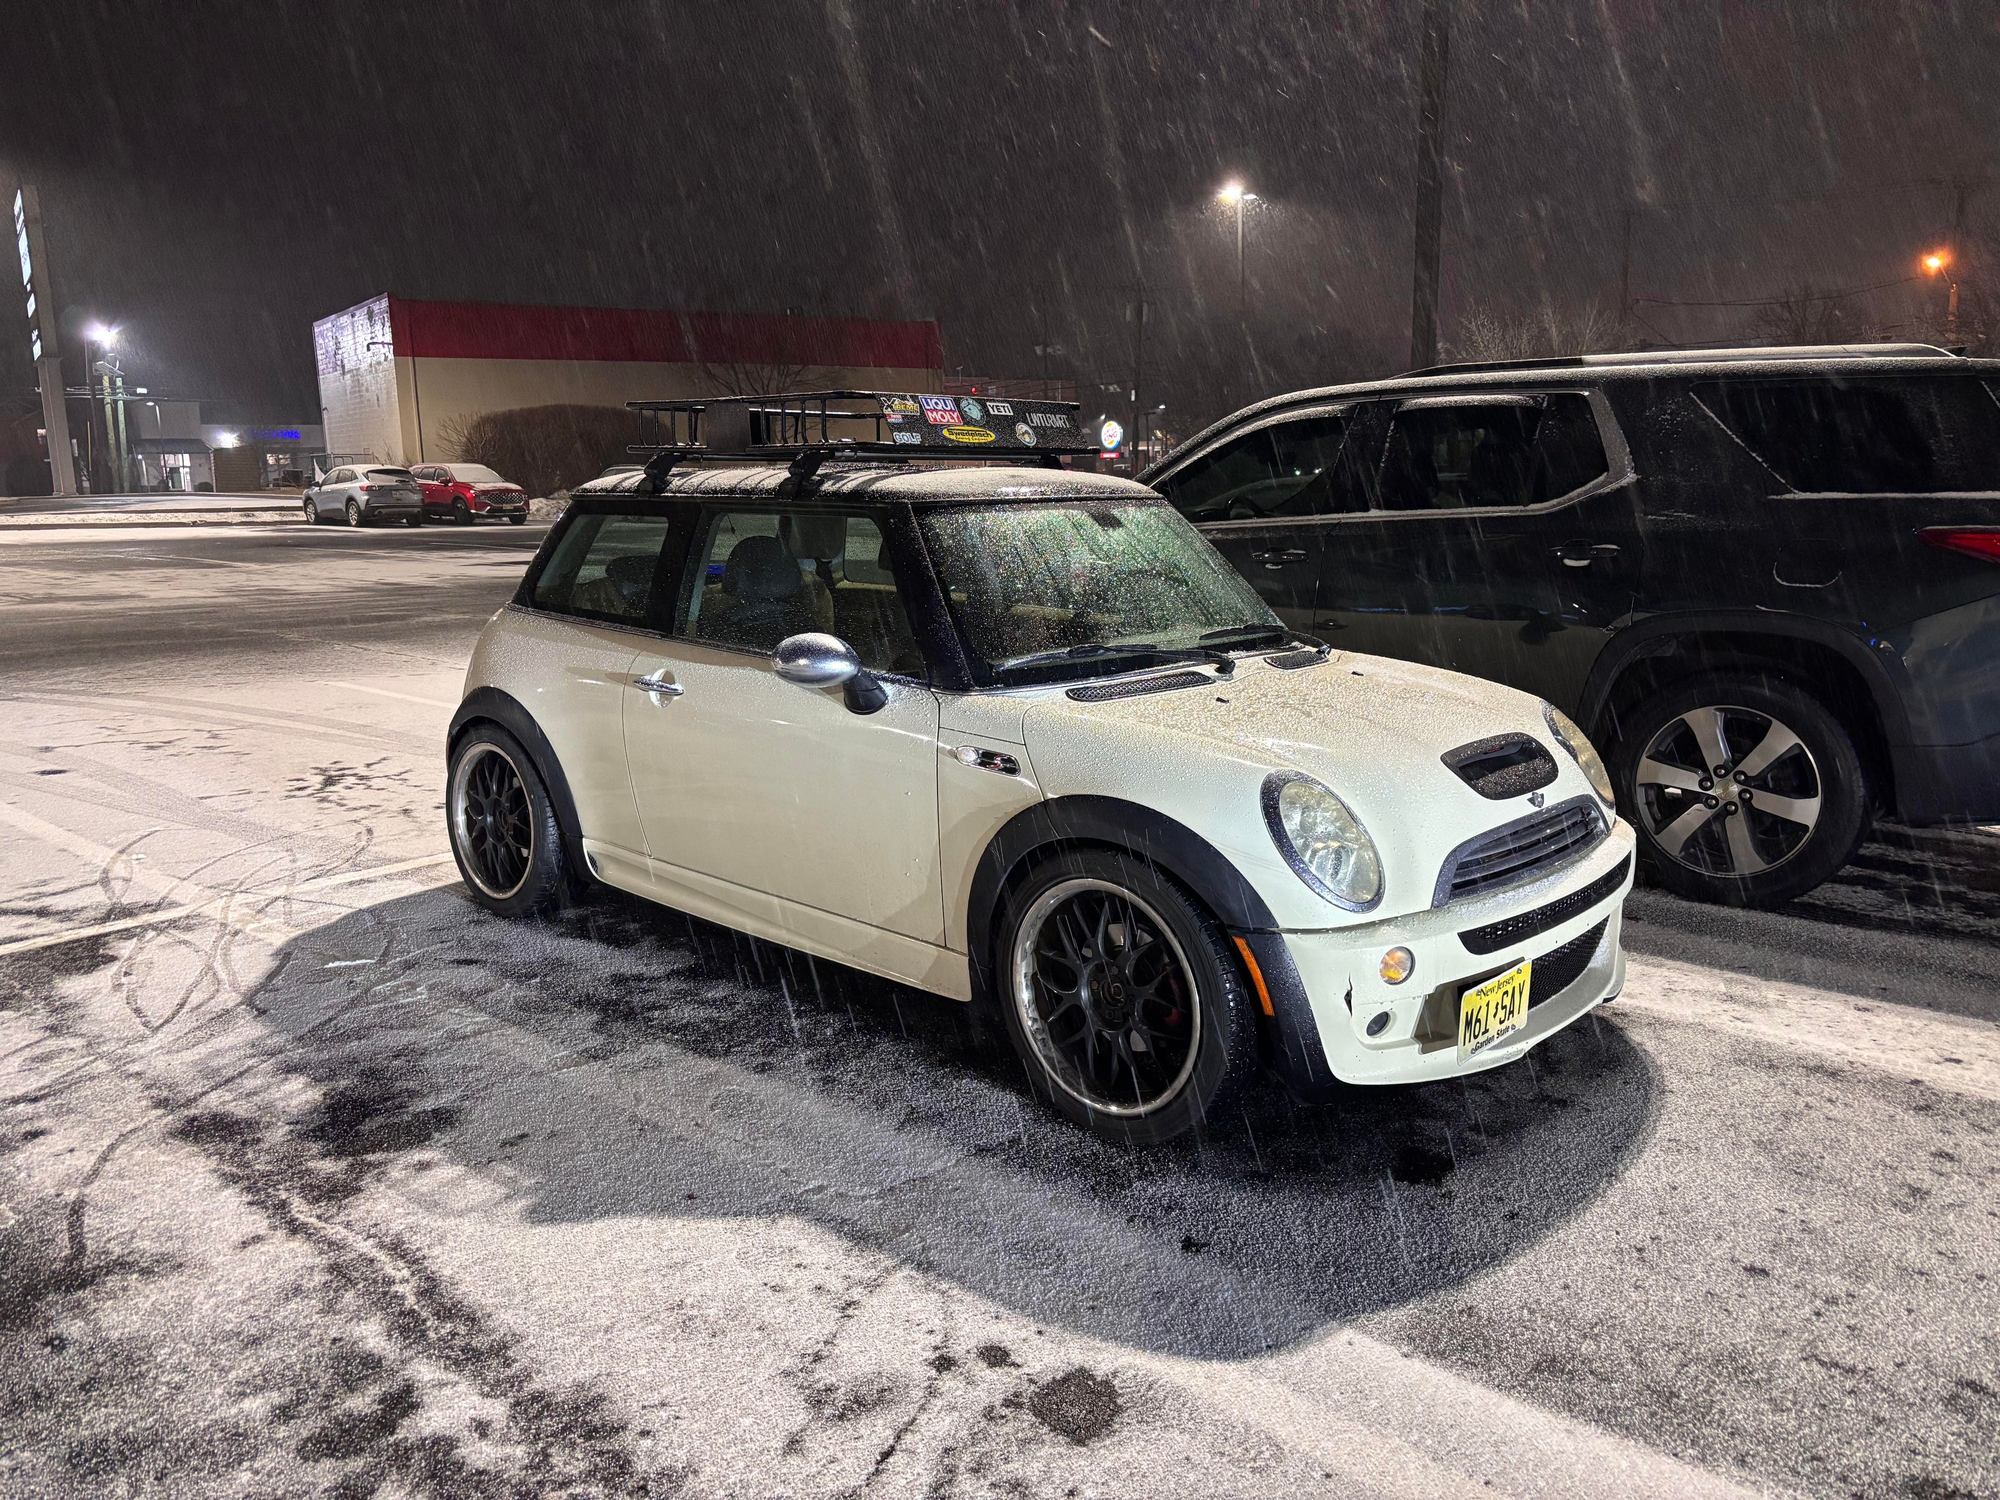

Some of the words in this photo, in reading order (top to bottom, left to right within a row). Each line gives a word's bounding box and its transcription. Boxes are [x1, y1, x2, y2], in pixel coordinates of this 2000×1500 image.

[921, 398, 956, 411] LIQUI
[988, 404, 1011, 414] YETI
[926, 410, 960, 423] MOLY
[893, 431, 922, 444] GOLF
[1479, 985, 1496, 1000] New
[1496, 974, 1516, 993] Jersey
[1475, 1034, 1495, 1051] Garden
[1496, 1025, 1510, 1039] State
